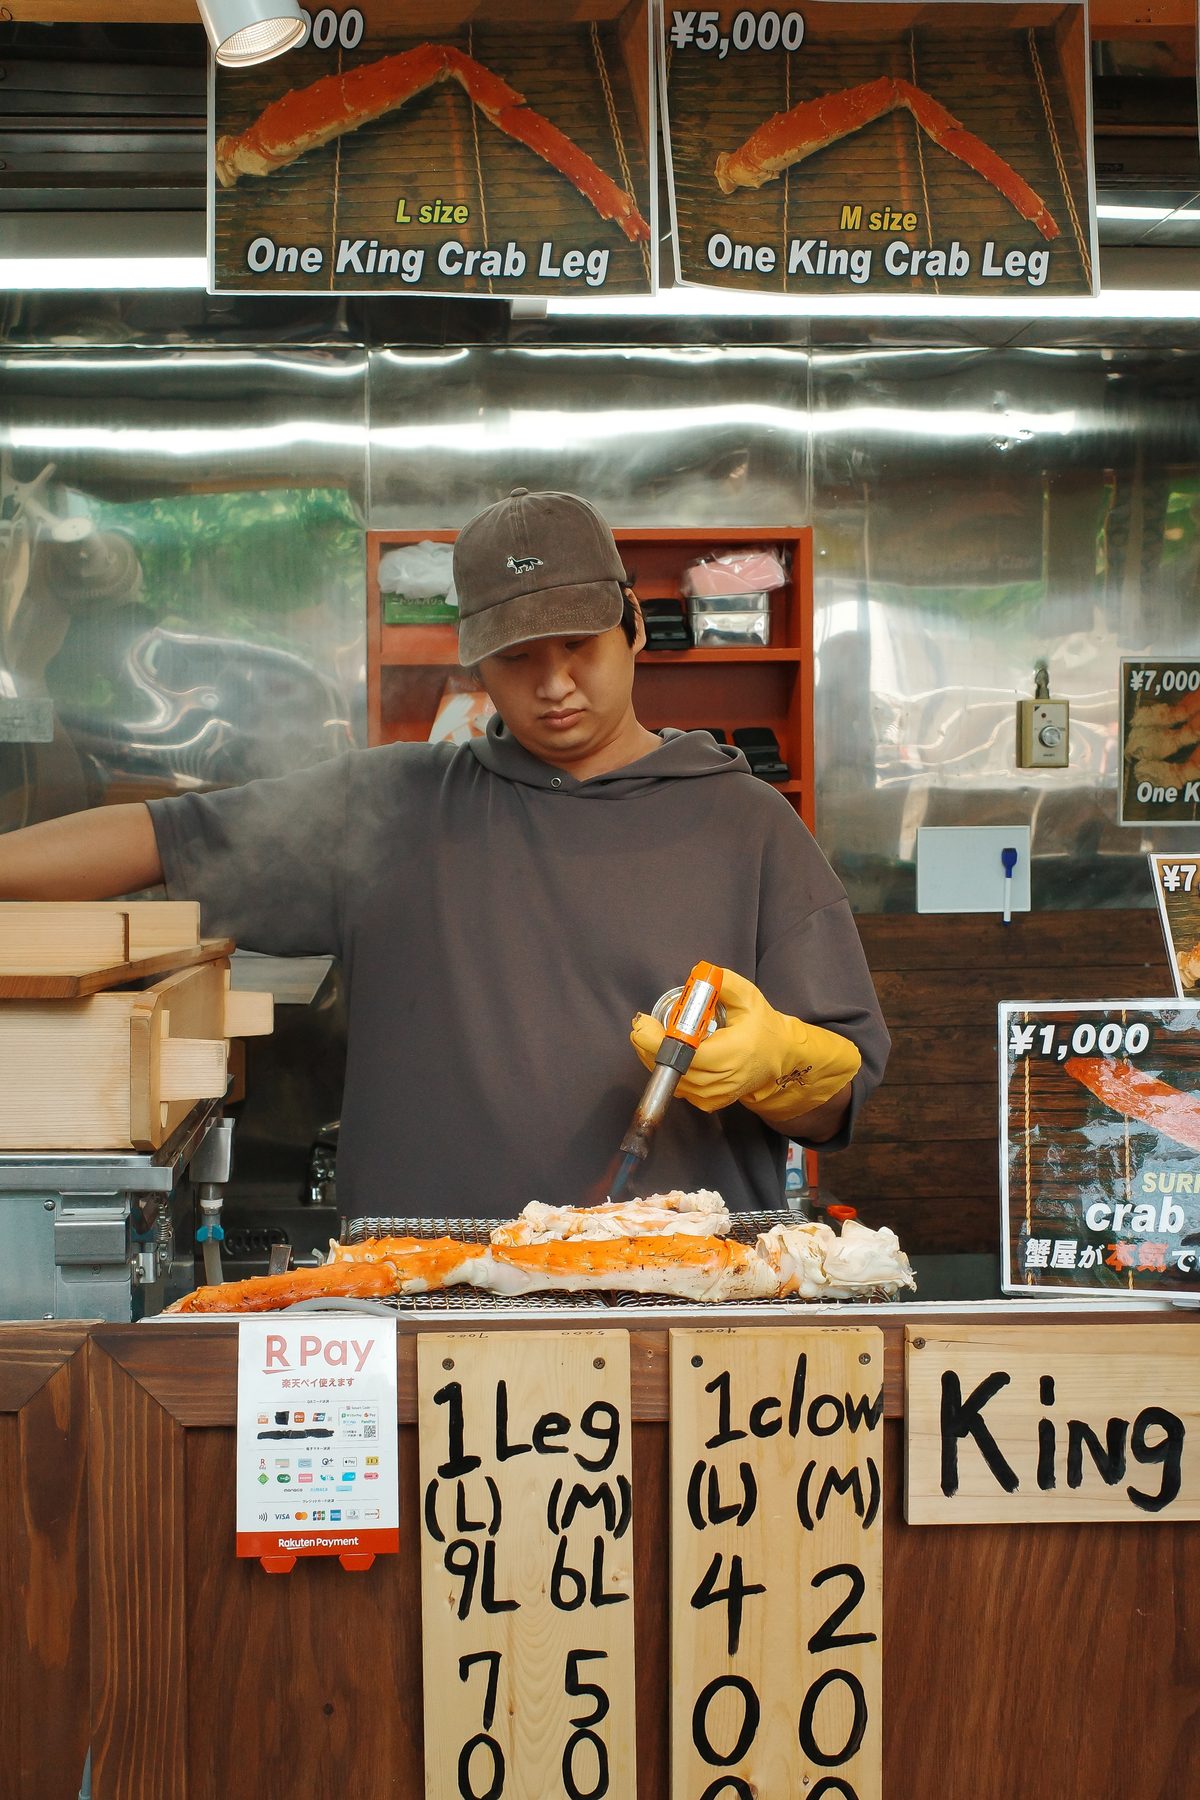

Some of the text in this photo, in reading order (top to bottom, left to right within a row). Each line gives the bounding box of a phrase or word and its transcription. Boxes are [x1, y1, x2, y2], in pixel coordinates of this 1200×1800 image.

[670, 11, 805, 60] ¥5,000
[396, 199, 469, 223] L size
[840, 205, 917, 231] M size
[247, 238, 610, 286] One King Crab Leg
[707, 234, 1050, 286] One King Crab Leg
[1136, 782, 1178, 803] One
[1008, 1023, 1150, 1061] ¥1,000
[1085, 1196, 1185, 1234] crab
[300, 1335, 375, 1372] Pay
[281, 1377, 354, 1389] 楽天ペイ使えます
[940, 1370, 1186, 1513] King
[278, 1536, 359, 1550] Rakuten Payment
